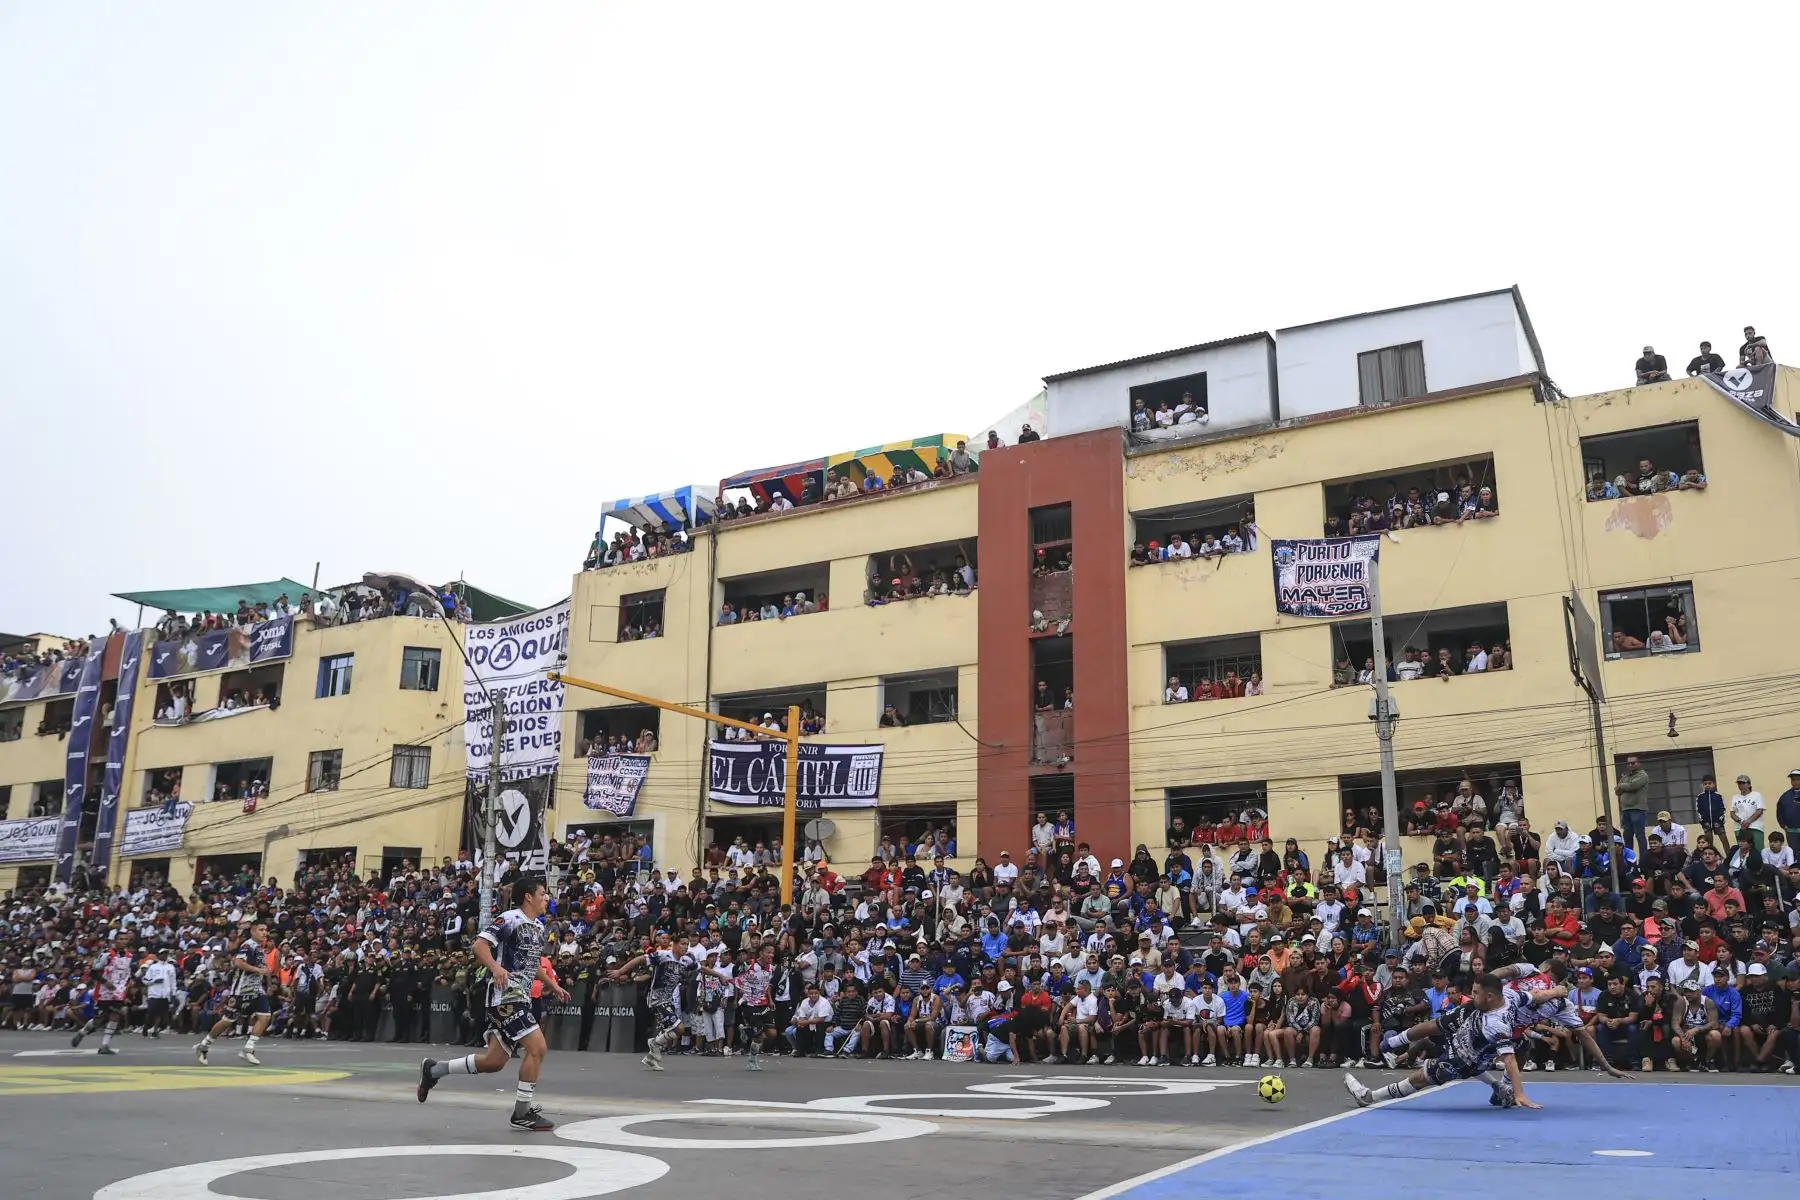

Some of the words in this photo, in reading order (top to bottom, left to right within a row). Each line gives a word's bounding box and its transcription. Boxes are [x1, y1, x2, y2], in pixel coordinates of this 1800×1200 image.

[1297, 542, 1351, 562] PURITO
[1296, 562, 1365, 585] PORVENIR
[1282, 586, 1365, 602] MAYER
[1327, 600, 1367, 613] sport
[470, 628, 494, 640] LOS
[499, 616, 553, 637] AMIGOS
[507, 716, 548, 734] DIOS
[768, 743, 818, 755] PORENIR
[711, 755, 741, 793] EL
[747, 753, 846, 797] CÁTEL
[761, 796, 773, 805] LA
[774, 797, 818, 809] VIORIA
